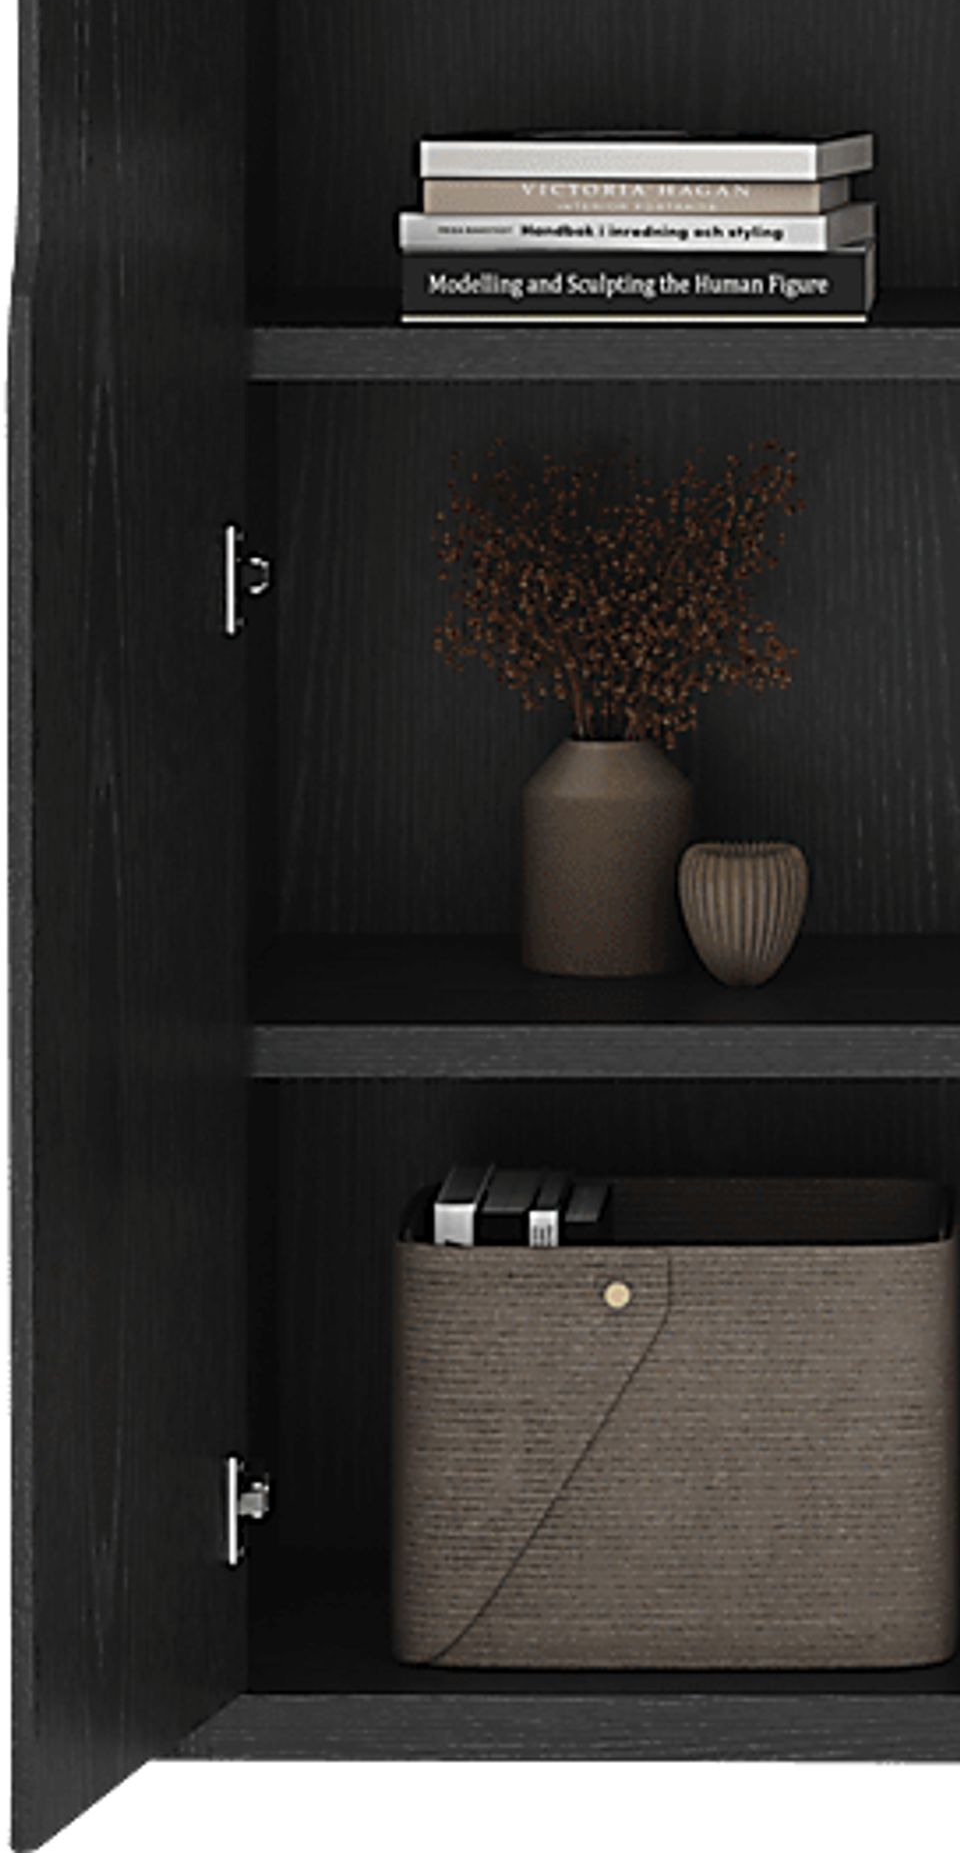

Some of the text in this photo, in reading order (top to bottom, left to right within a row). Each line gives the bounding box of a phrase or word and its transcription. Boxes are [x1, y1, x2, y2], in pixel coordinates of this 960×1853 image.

[521, 183, 750, 197] VICTORIA HAGAN
[520, 224, 594, 237] Handbok
[598, 225, 604, 237] i
[727, 225, 784, 241] styling
[428, 271, 829, 300] Modelling and Sculpting the Human Figure
